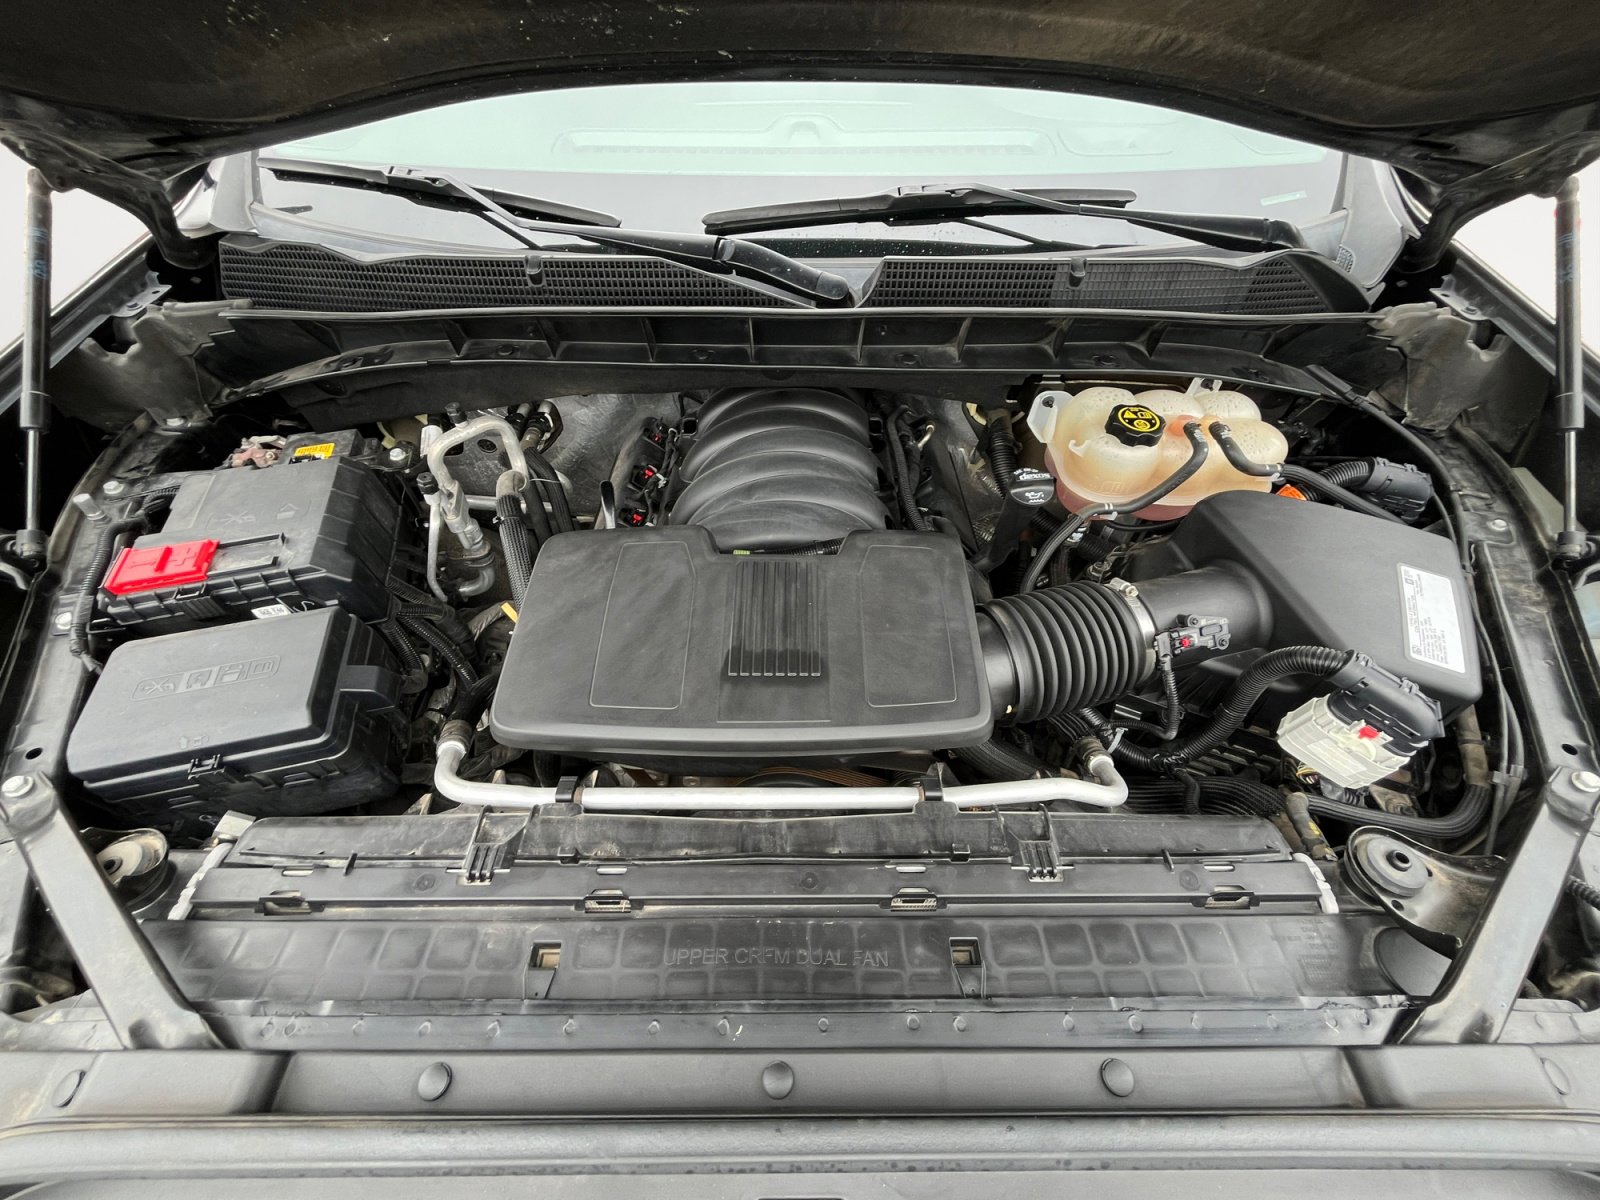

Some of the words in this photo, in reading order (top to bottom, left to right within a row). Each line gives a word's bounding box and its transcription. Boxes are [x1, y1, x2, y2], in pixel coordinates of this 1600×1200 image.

[663, 947, 729, 967] UPPER
[734, 947, 791, 966] CRFM
[796, 947, 848, 966] DUAL
[852, 949, 889, 967] FAN
